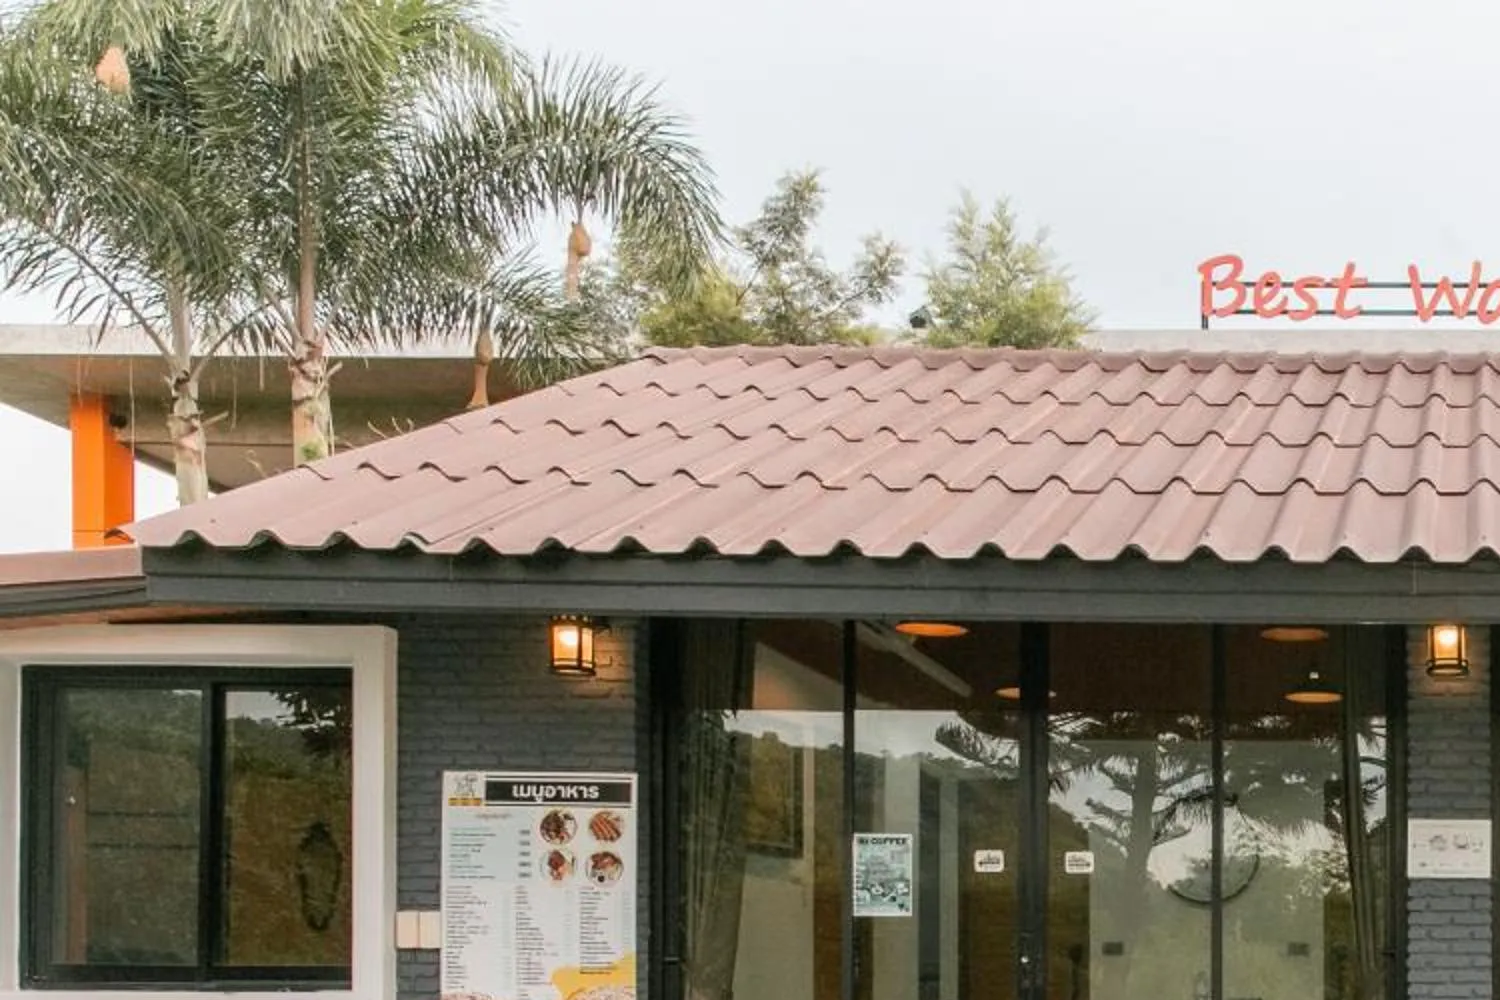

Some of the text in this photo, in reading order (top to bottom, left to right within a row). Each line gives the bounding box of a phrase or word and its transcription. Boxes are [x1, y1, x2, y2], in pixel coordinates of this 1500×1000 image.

[1198, 254, 1368, 321] Best
[512, 784, 600, 803] เมนูอาหาร
